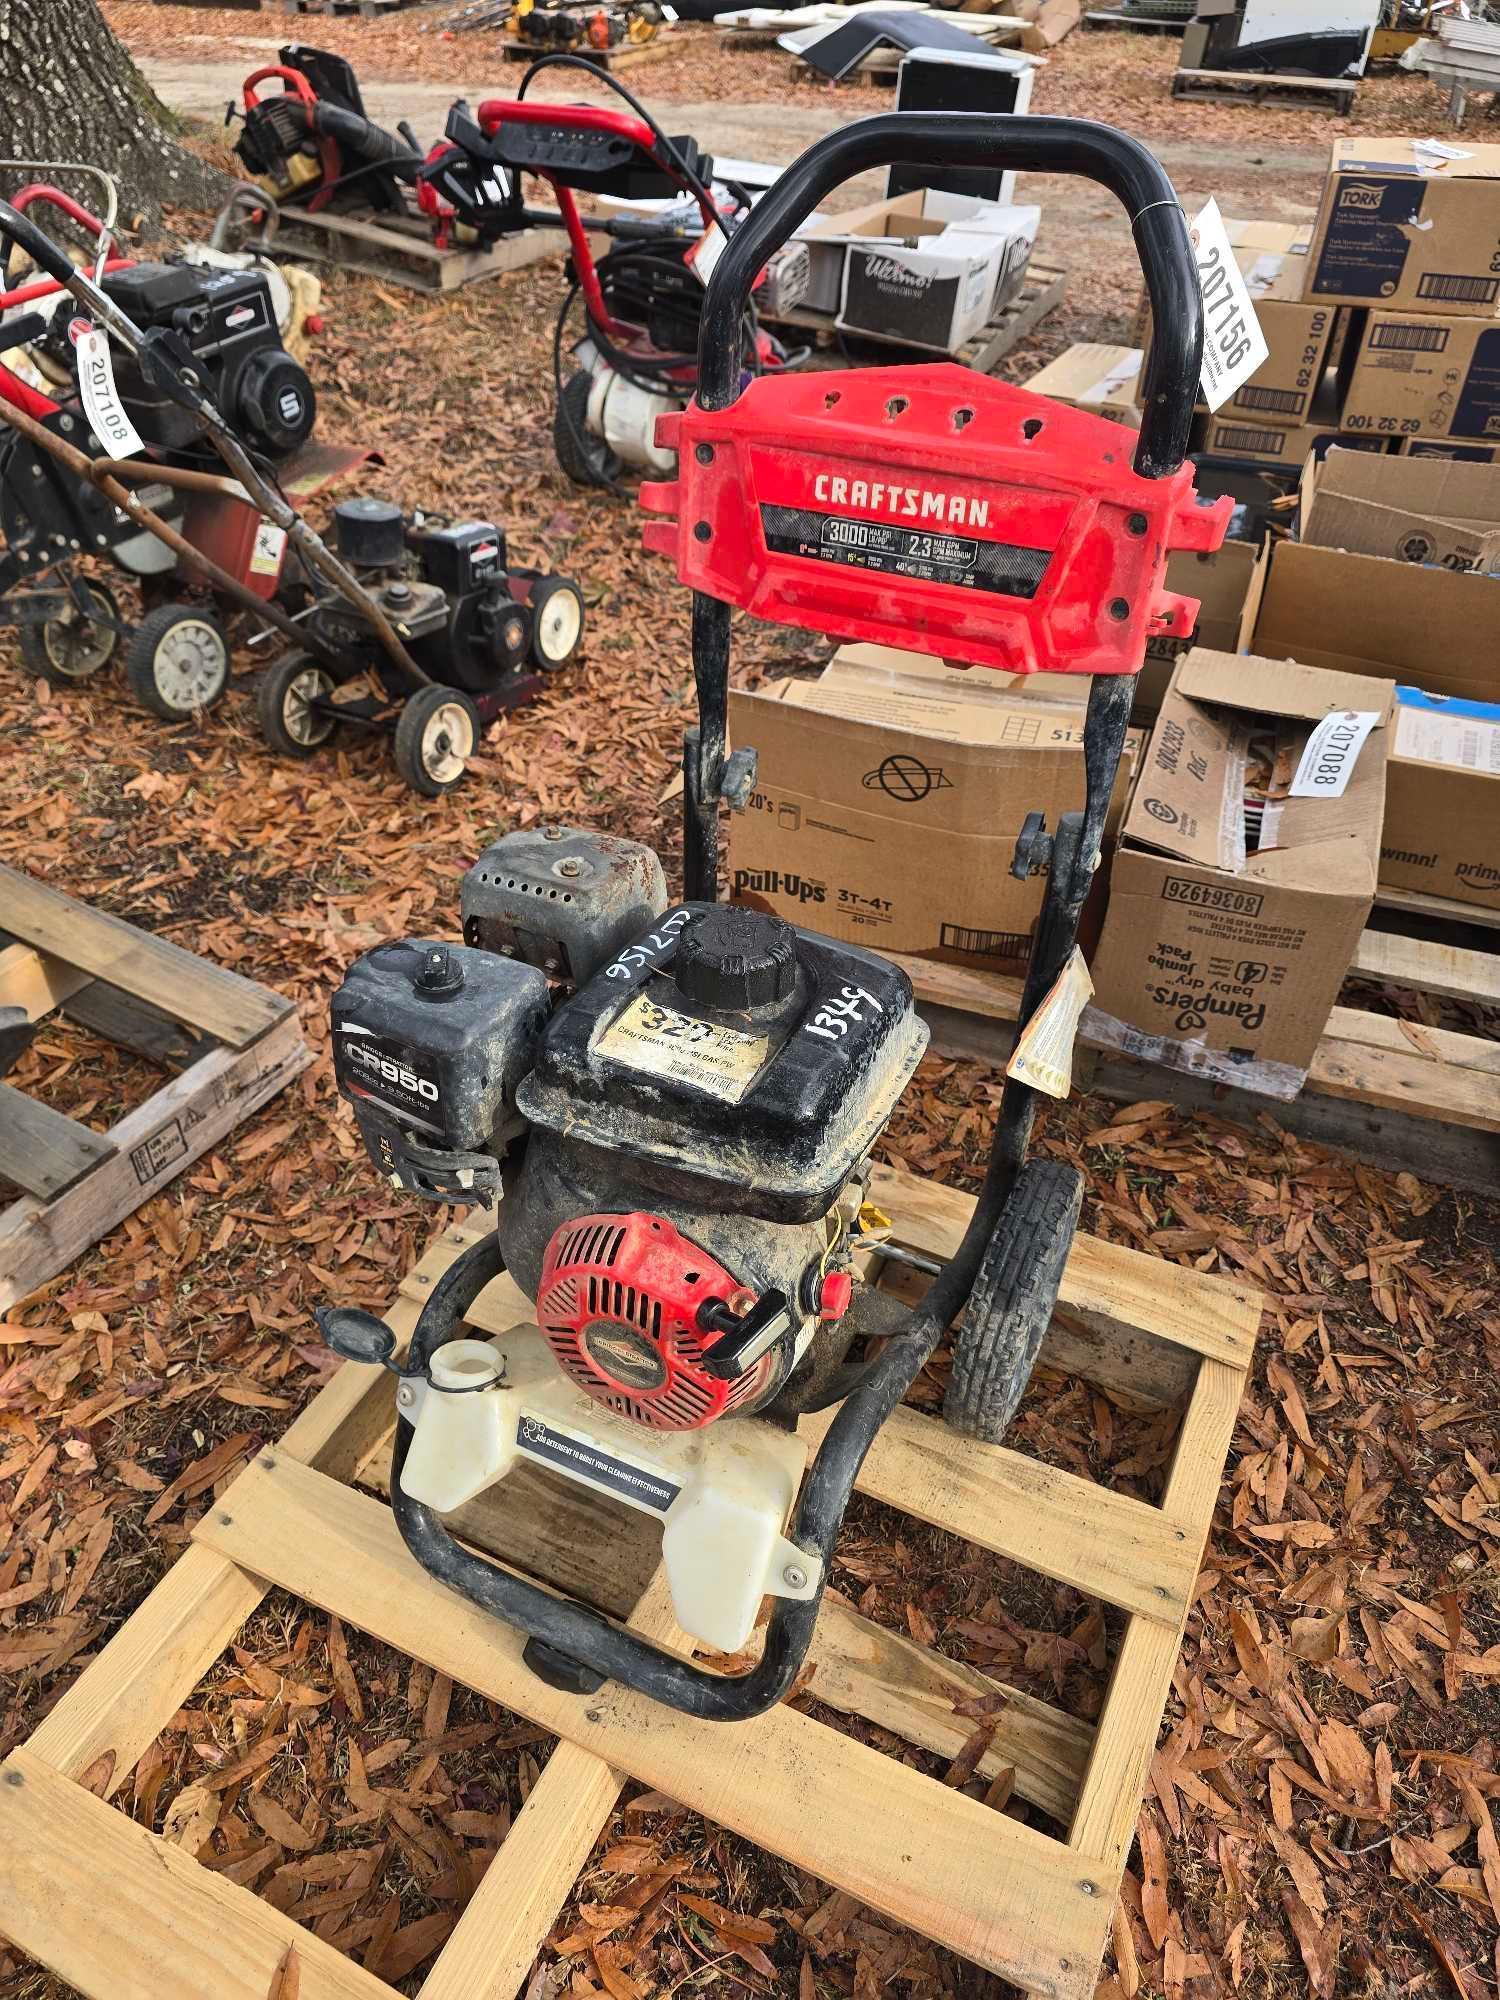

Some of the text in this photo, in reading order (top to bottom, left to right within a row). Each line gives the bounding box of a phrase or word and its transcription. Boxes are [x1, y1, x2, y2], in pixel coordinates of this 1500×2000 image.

[1341, 190, 1381, 206] TORK
[1199, 246, 1252, 371] 207156
[1297, 311, 1328, 388] 62 32 100
[91, 358, 128, 441] 207108
[1346, 414, 1421, 433] 62 32 100
[815, 474, 990, 528] CRAFTSMAN
[829, 521, 869, 546] 3000
[909, 535, 932, 557] 2.3
[1314, 725, 1360, 785] 207088
[1455, 862, 1500, 881] prim
[838, 889, 893, 911] 3T-4T
[1168, 881, 1258, 914] 80364926
[1156, 942, 1192, 961] Pack
[1148, 954, 1198, 975] Jumbo
[1241, 961, 1261, 984] 4
[1209, 981, 1254, 998] baby
[803, 986, 884, 1040] 1349
[617, 1024, 665, 1047] CRAFTSMAN
[346, 1042, 439, 1102] CR950
[631, 1475, 671, 1500] EFFECTIVENESS
